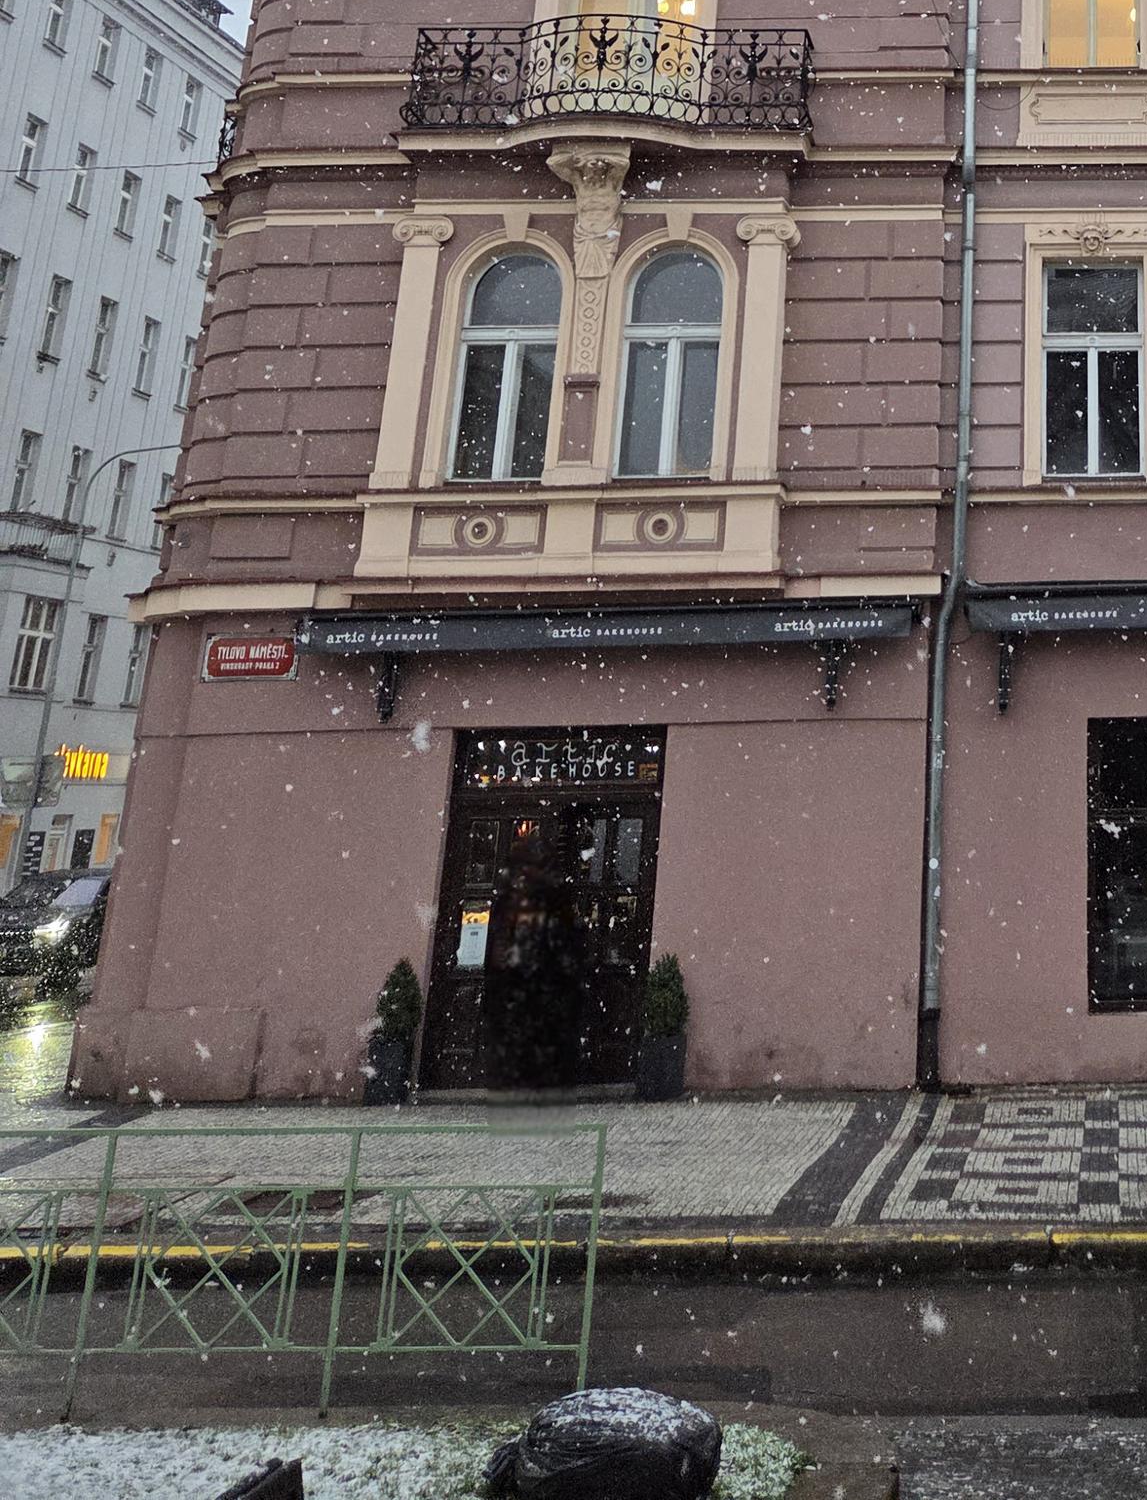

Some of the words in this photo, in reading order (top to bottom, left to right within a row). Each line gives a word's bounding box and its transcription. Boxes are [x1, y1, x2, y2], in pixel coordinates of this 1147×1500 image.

[1010, 609, 1049, 622] artic
[1054, 610, 1118, 619] BAKEHOUSE
[551, 626, 591, 638] artic
[597, 626, 663, 636] BAKEHOUSE
[774, 618, 815, 632] artic
[818, 620, 883, 629] BAKEHOUSE
[326, 632, 365, 645] artic
[371, 632, 438, 642] BAKEHOUSE
[218, 646, 246, 660] TYLOVO
[249, 643, 287, 660] NÁMĚSTÍ
[511, 740, 616, 766] artic
[497, 760, 635, 780] BAKEHOUSE
